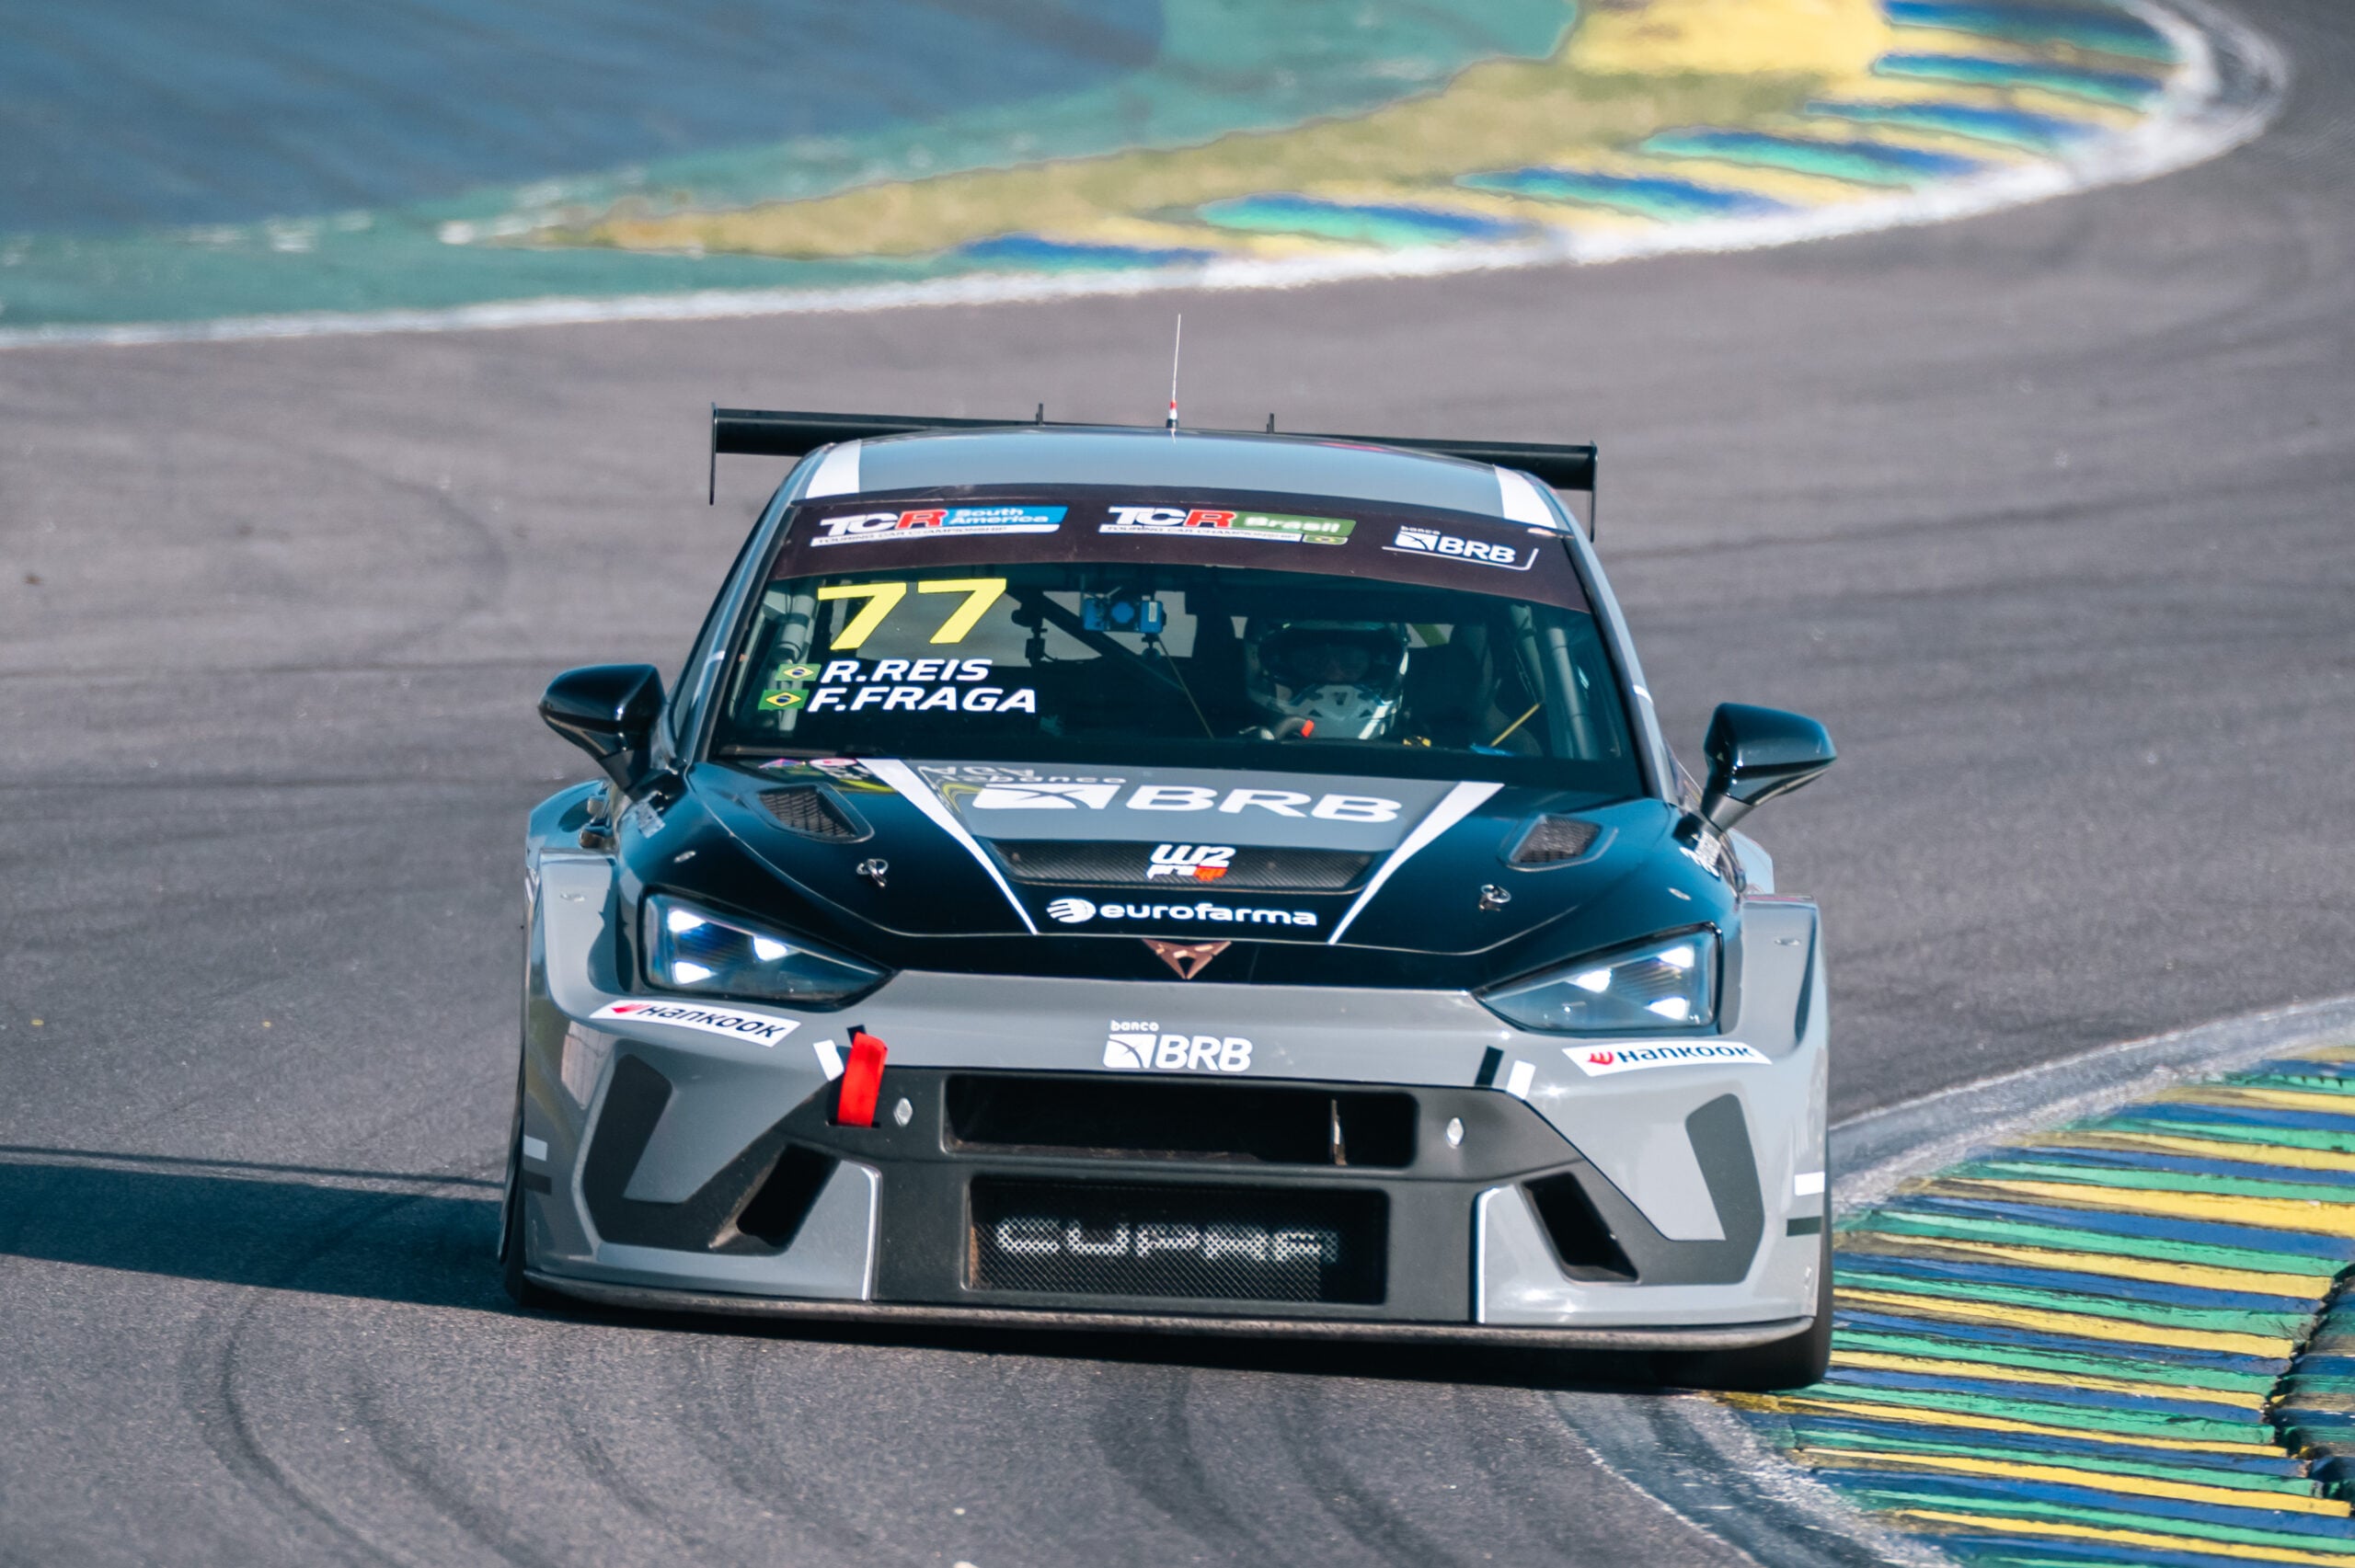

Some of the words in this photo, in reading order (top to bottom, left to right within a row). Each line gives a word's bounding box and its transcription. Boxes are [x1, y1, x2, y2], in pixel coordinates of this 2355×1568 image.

[820, 508, 948, 537] TCR
[955, 507, 1025, 517] South
[948, 514, 1049, 525] America
[1108, 506, 1237, 528] TCR
[1243, 515, 1341, 533] Brasil
[1400, 524, 1442, 535] banco
[1437, 536, 1517, 564] BRB
[818, 578, 1007, 650] 77
[820, 658, 994, 684] R.REIS
[806, 685, 1037, 714] F.FRAGA
[1125, 784, 1404, 824] BRB
[1099, 901, 1318, 927] eurofarma
[1109, 1020, 1160, 1032] banco
[1155, 1034, 1254, 1072] BRB
